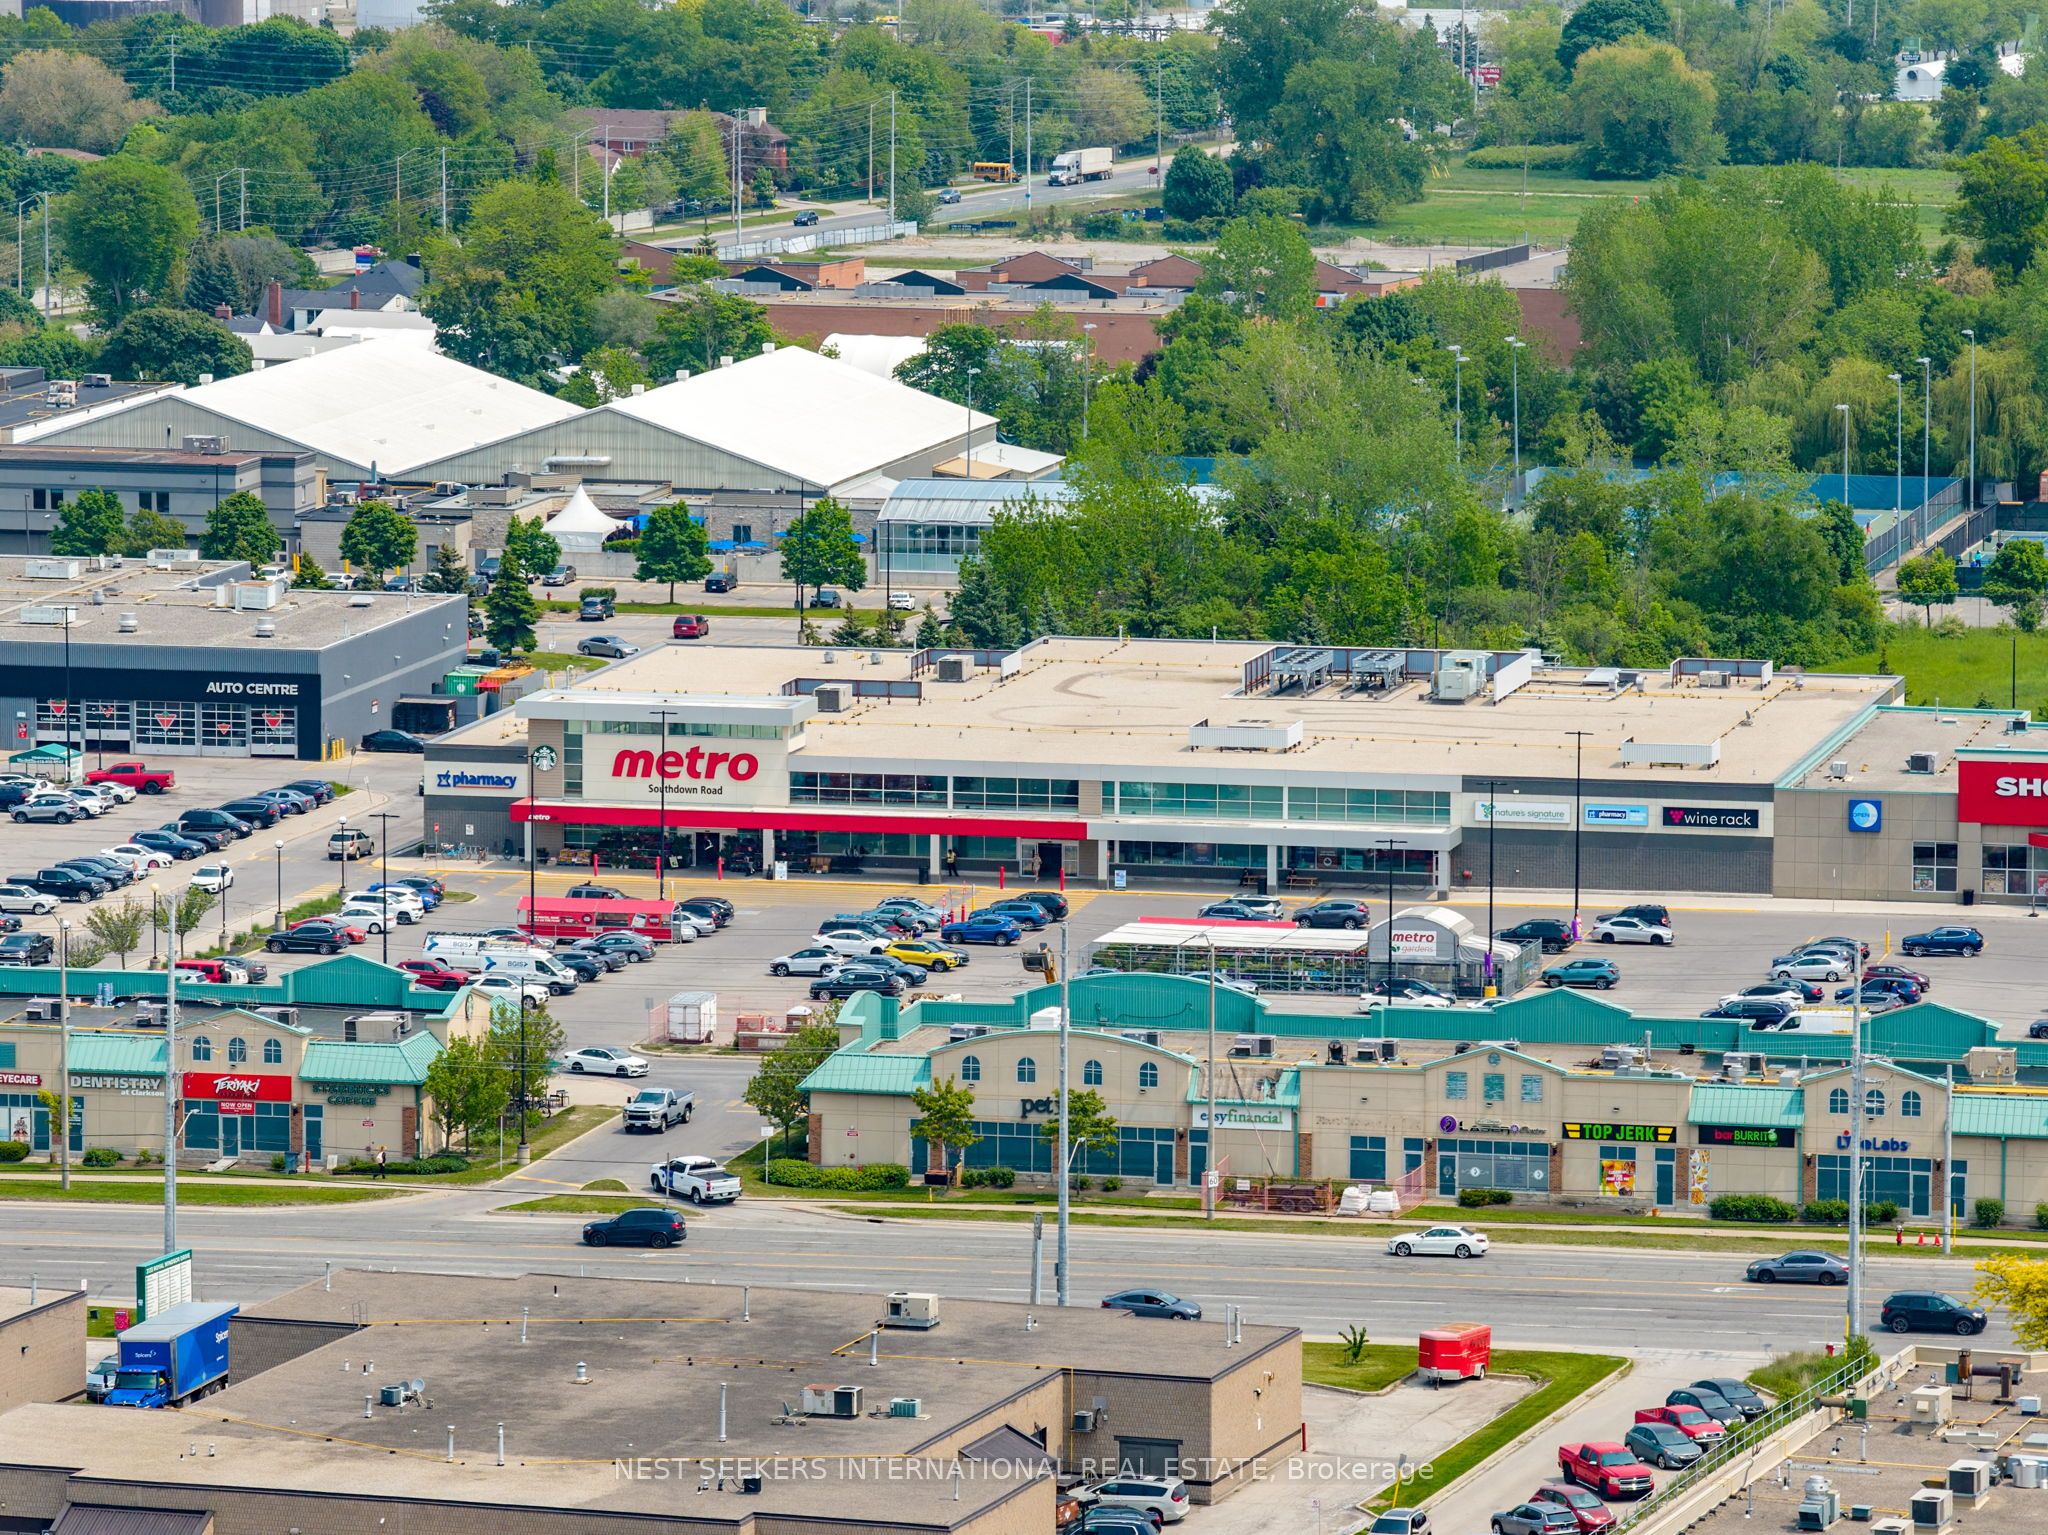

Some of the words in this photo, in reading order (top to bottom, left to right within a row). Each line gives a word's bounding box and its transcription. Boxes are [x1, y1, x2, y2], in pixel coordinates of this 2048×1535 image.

[206, 682, 243, 694] AUTO
[246, 683, 299, 696] CENTRE
[612, 746, 759, 781] metro
[453, 771, 517, 789] pharmacy
[648, 784, 698, 794] Southdown
[700, 785, 723, 795] Road
[528, 812, 551, 821] metro
[1495, 809, 1526, 818] nature's
[1527, 810, 1565, 820] signature
[1598, 810, 1626, 819] pharmacy
[1684, 812, 1718, 825] wine
[1720, 813, 1752, 826] rack
[1393, 932, 1435, 943] metro
[1401, 945, 1434, 954] gardens
[508, 960, 524, 968] BGIS
[70, 1076, 161, 1090] DENTISTRY
[131, 1089, 165, 1097] Clarkson
[312, 1084, 392, 1095] STARBUCKS
[327, 1095, 377, 1106] COFFEE
[1020, 1096, 1053, 1118] pet
[1583, 1124, 1612, 1139] TOP
[1616, 1126, 1655, 1141] JERK
[1209, 1178, 1218, 1186] 60
